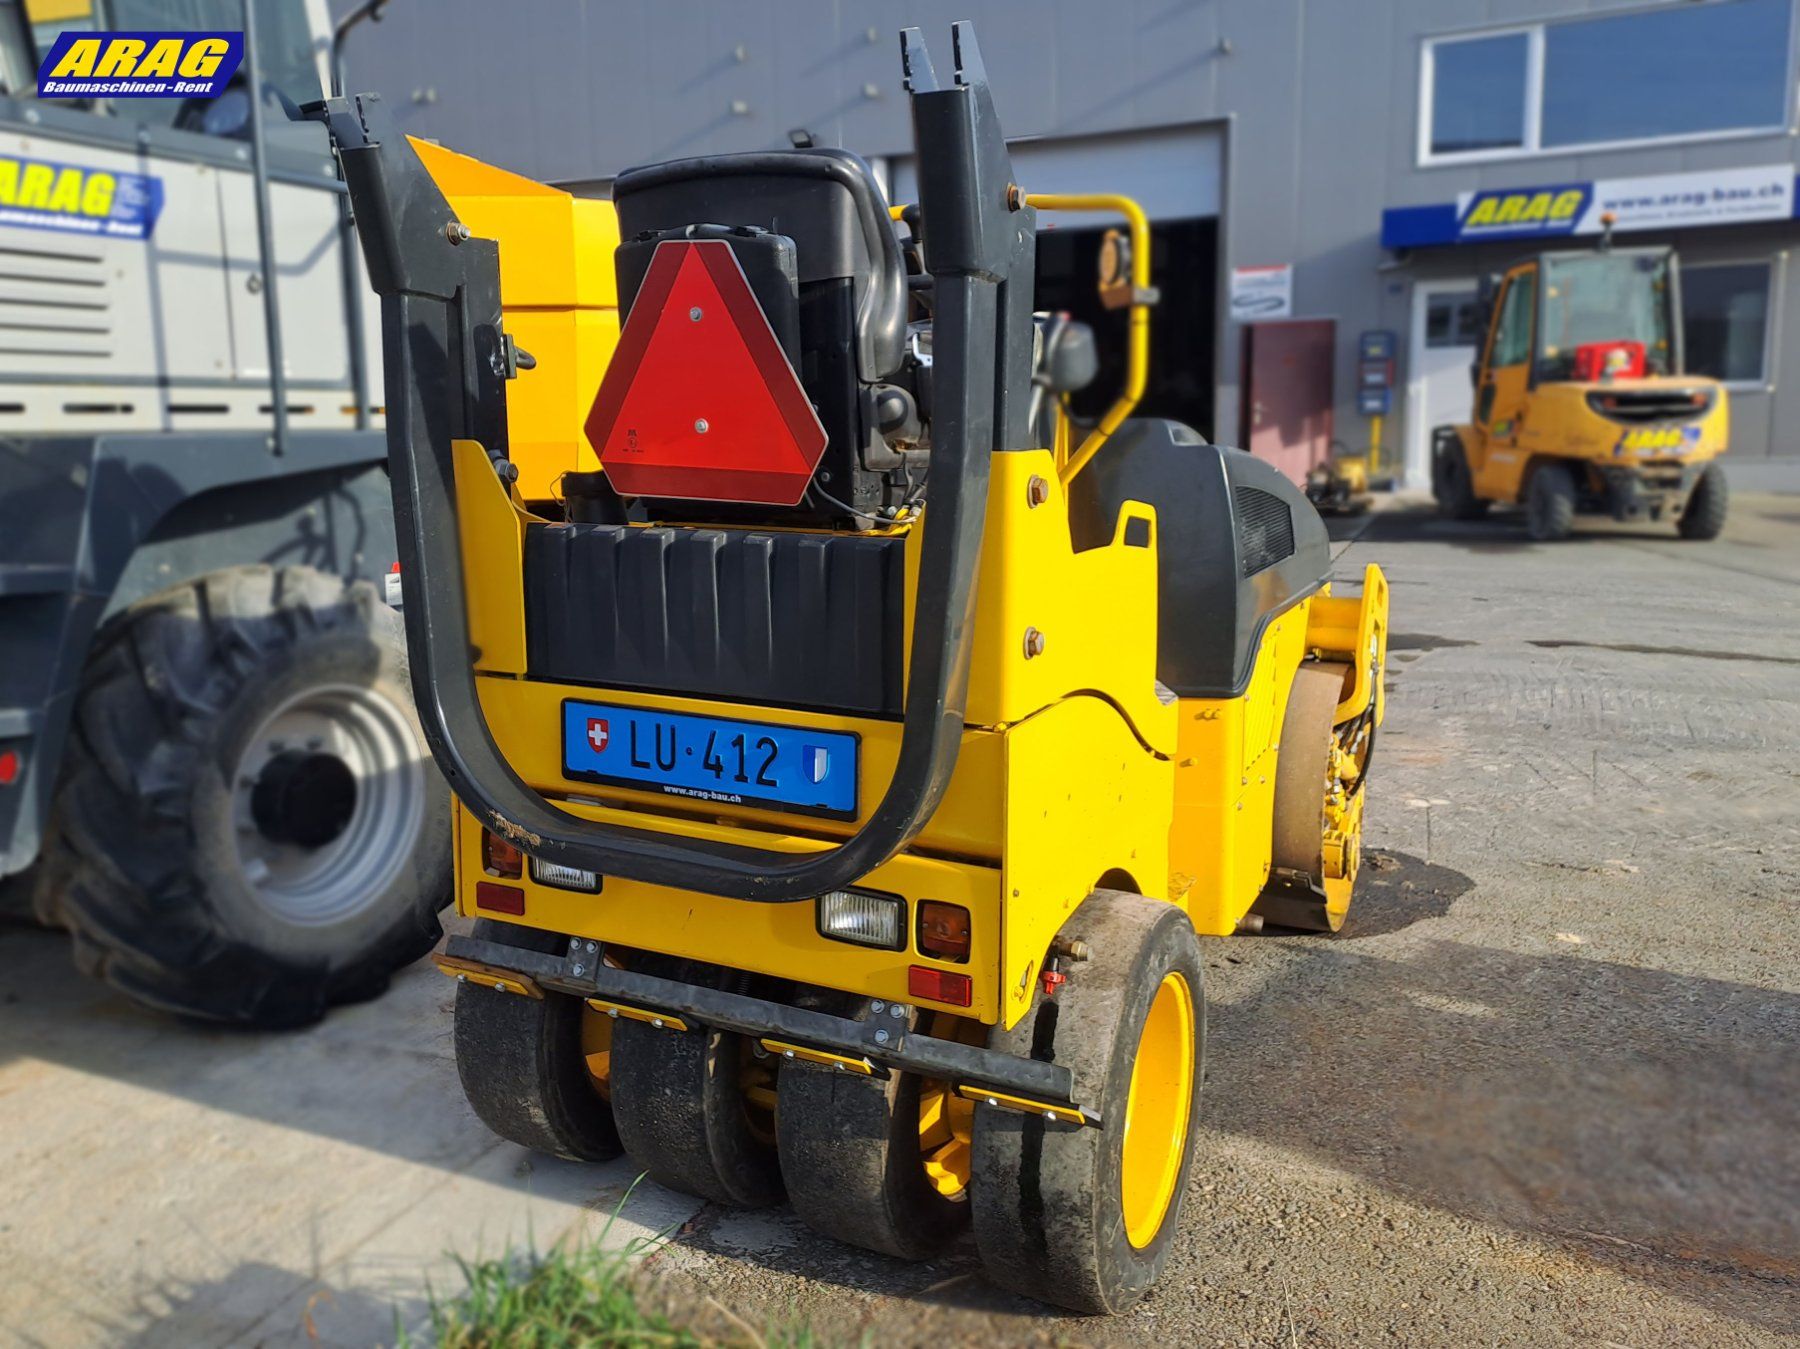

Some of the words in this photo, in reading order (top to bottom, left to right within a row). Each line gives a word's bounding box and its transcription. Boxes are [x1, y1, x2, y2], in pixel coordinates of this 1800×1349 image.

[1602, 182, 1784, 210] www.arag-bau.ch
[1465, 189, 1584, 228] ARAG
[1622, 429, 1683, 449] ARAG
[663, 784, 742, 803] www.arag-bau.ch
